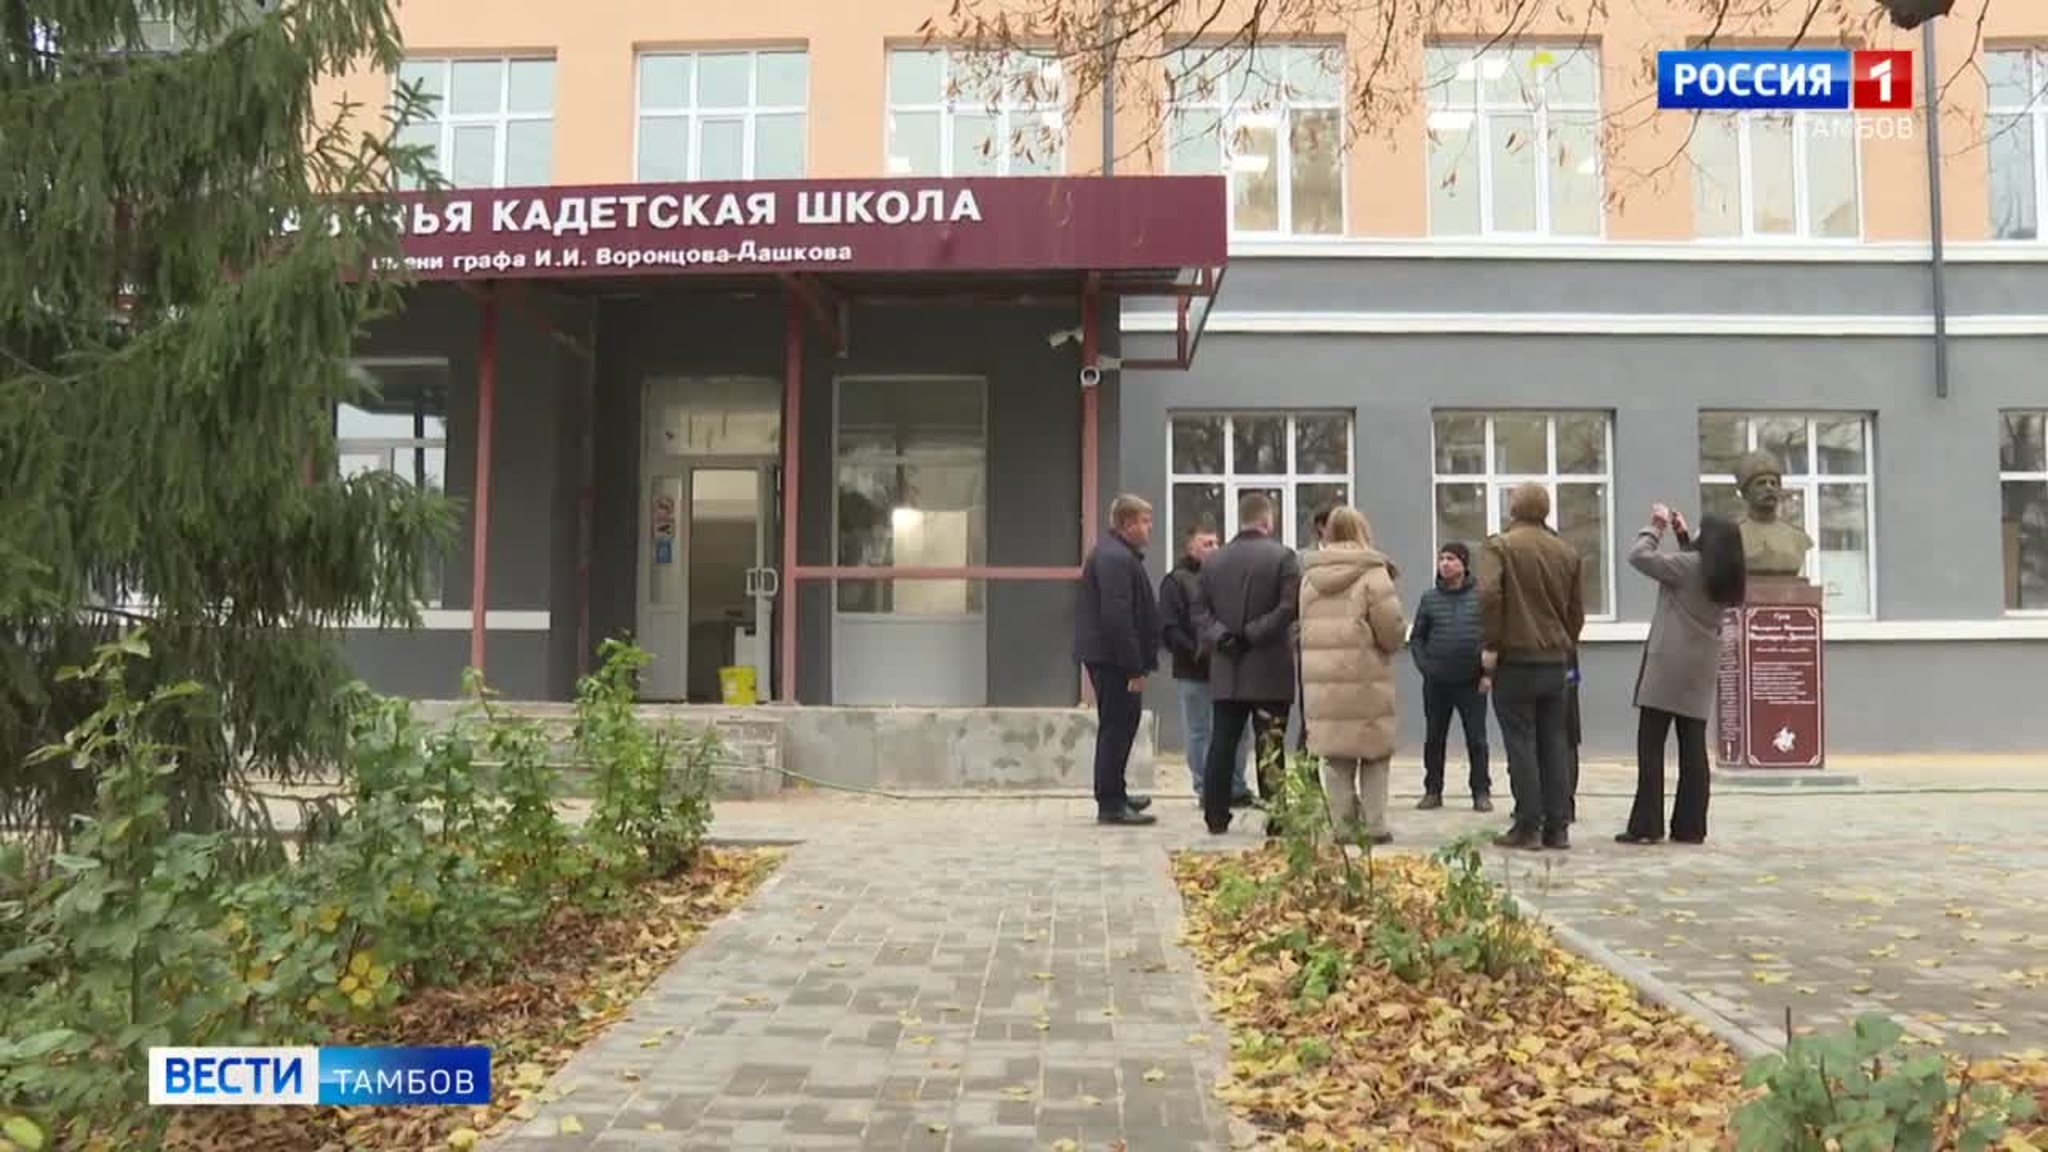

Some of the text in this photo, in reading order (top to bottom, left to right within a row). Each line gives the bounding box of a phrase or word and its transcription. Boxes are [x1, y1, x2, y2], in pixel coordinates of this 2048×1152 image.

[492, 191, 777, 237] КАДЕТСКАЯ
[797, 188, 983, 225] ШКОЛА
[453, 251, 526, 272] графа
[534, 248, 588, 268] И.И.
[596, 240, 853, 269] Воронцова-Дашкова
